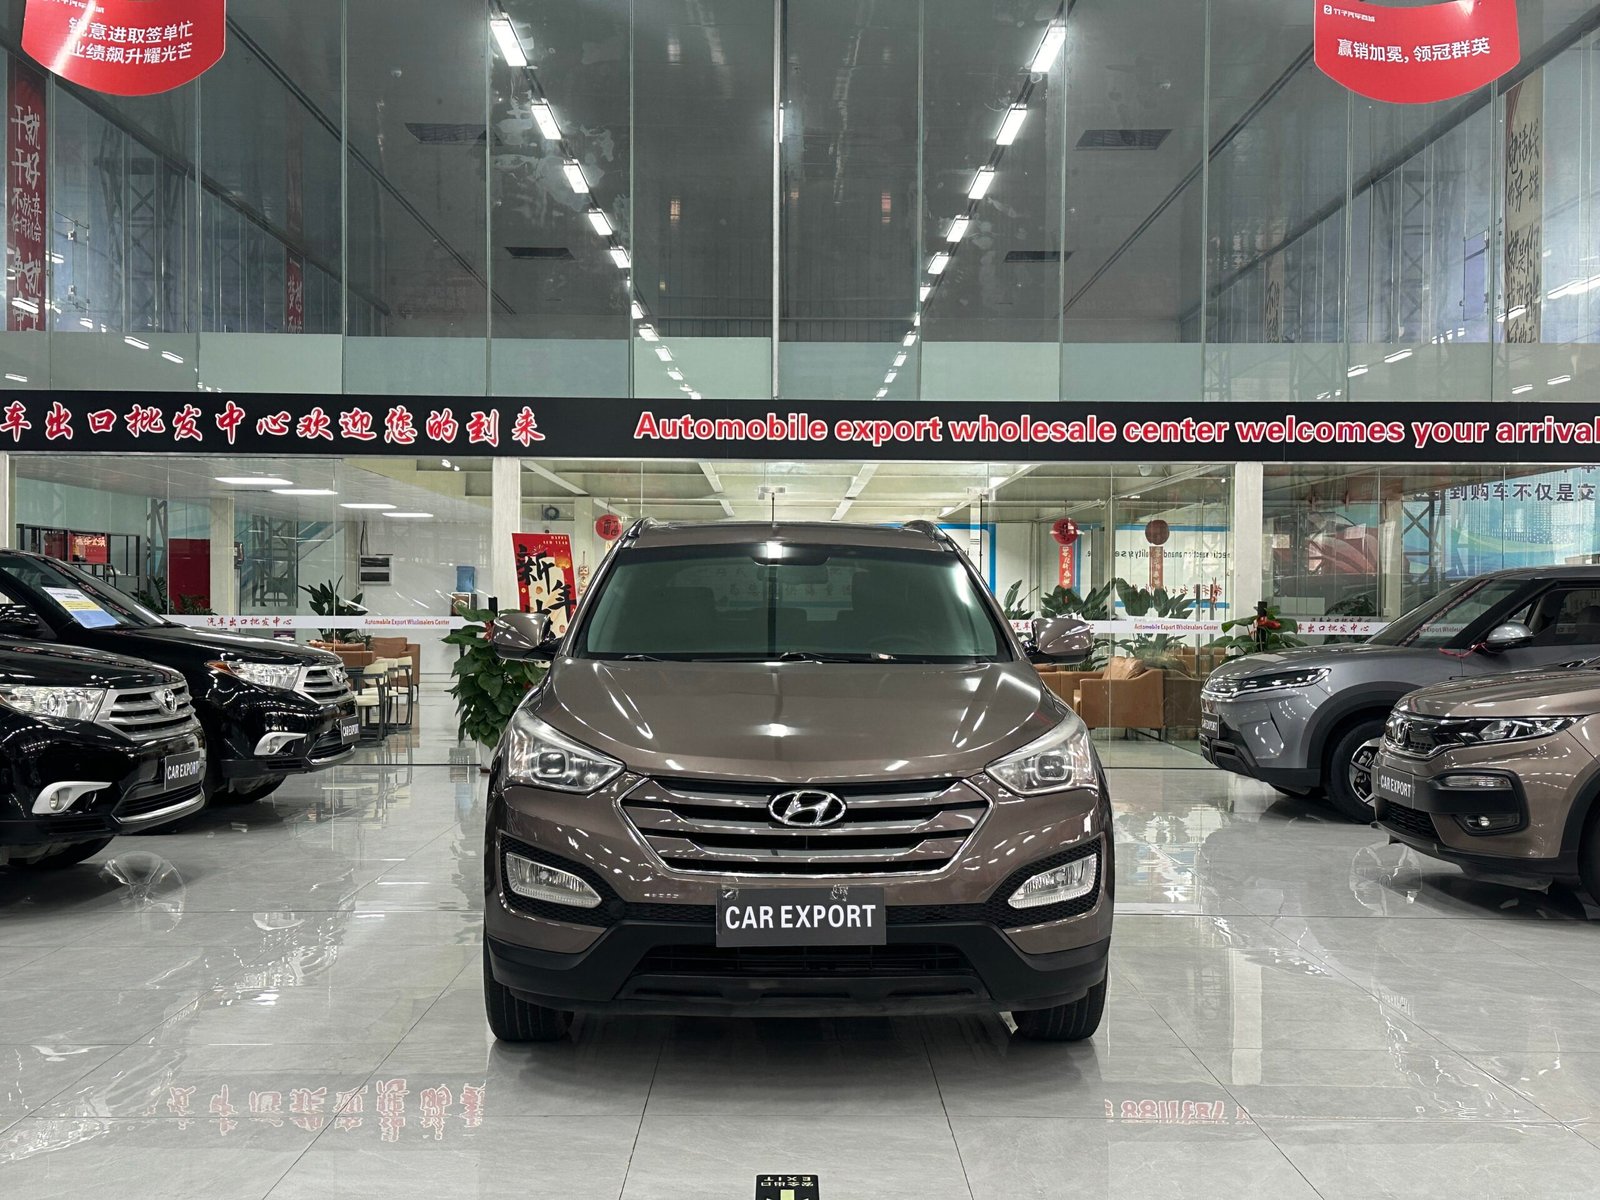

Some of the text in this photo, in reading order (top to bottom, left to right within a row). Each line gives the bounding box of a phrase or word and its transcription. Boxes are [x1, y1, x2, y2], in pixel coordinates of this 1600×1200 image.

[70, 41, 193, 65] 业绩飙升耀光芒
[0, 400, 547, 447] 车出口批发中心欢迎您的到来
[634, 411, 1600, 449] Automobile export wholesale center welcomes your arrival
[207, 616, 293, 627] 汽车出口批发中心
[167, 765, 180, 780] CAR
[1380, 774, 1412, 798] CAR EXPORT
[725, 904, 876, 930] CAR EXPORT
